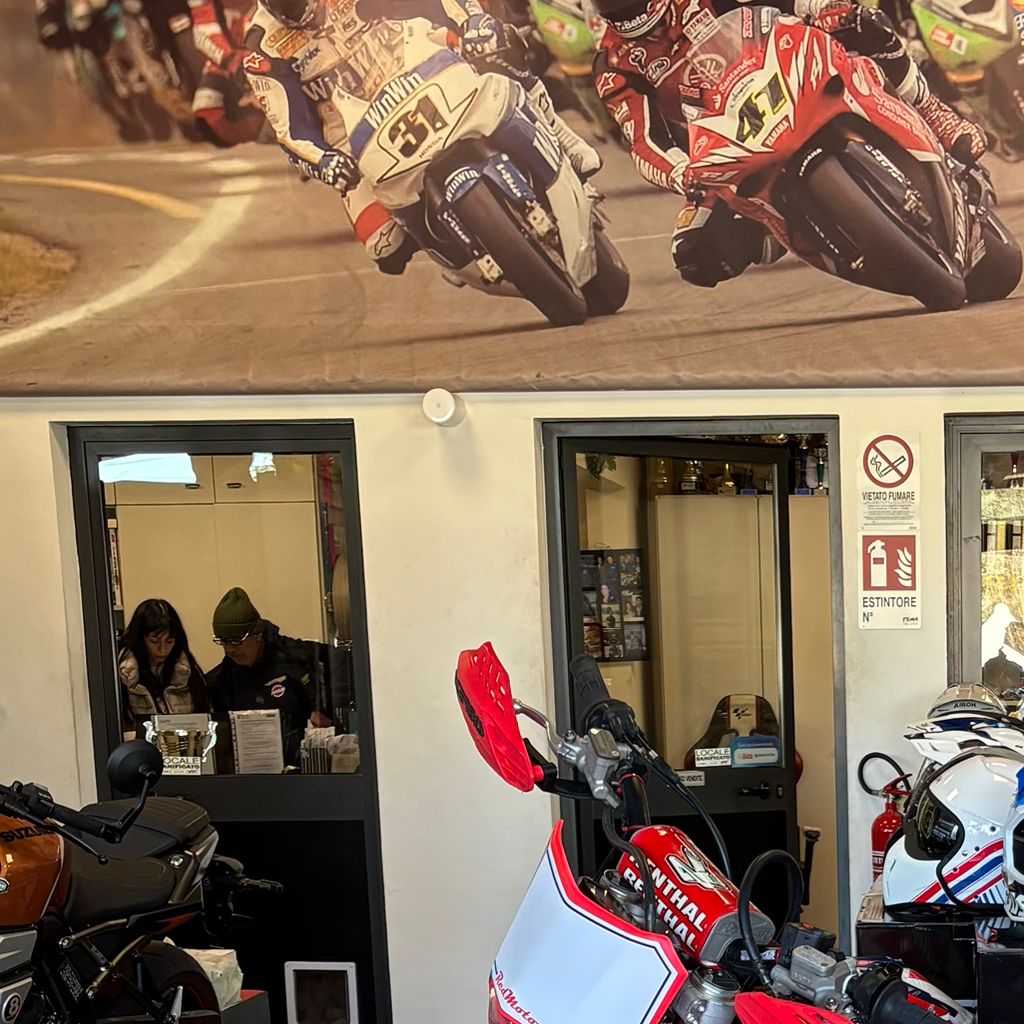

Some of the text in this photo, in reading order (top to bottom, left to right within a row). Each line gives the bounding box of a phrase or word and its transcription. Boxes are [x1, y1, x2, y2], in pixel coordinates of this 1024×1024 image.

[388, 95, 450, 158] 31
[735, 72, 787, 144] 41
[862, 491, 915, 501] VIETATO FUMARE
[862, 596, 917, 608] ESTINTORE
[695, 748, 730, 757] LOCALE
[622, 867, 698, 952] RETHAL
